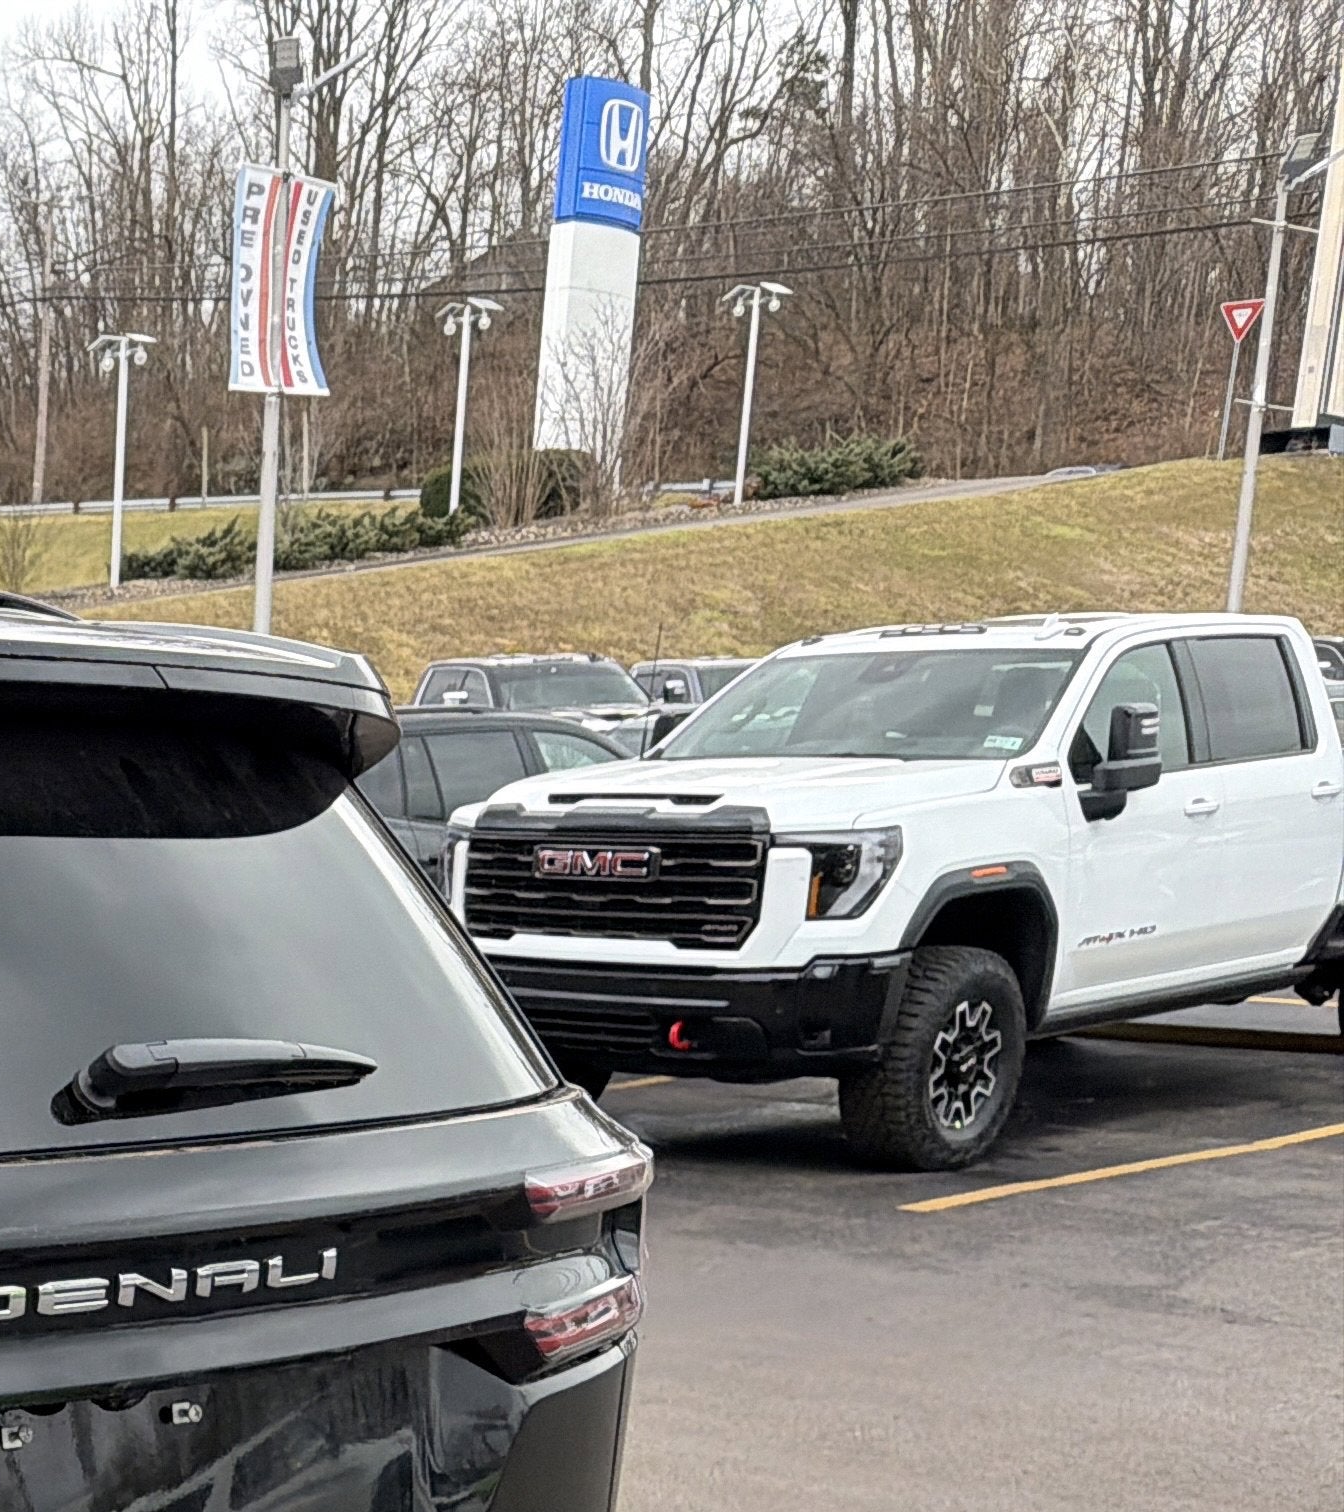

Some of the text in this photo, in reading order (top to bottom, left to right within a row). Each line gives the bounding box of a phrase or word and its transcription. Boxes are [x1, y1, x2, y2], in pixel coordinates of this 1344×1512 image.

[239, 181, 266, 249] PRE
[581, 181, 642, 211] HONDA
[285, 189, 319, 384] USED TRUCKS
[537, 848, 652, 878] GMC
